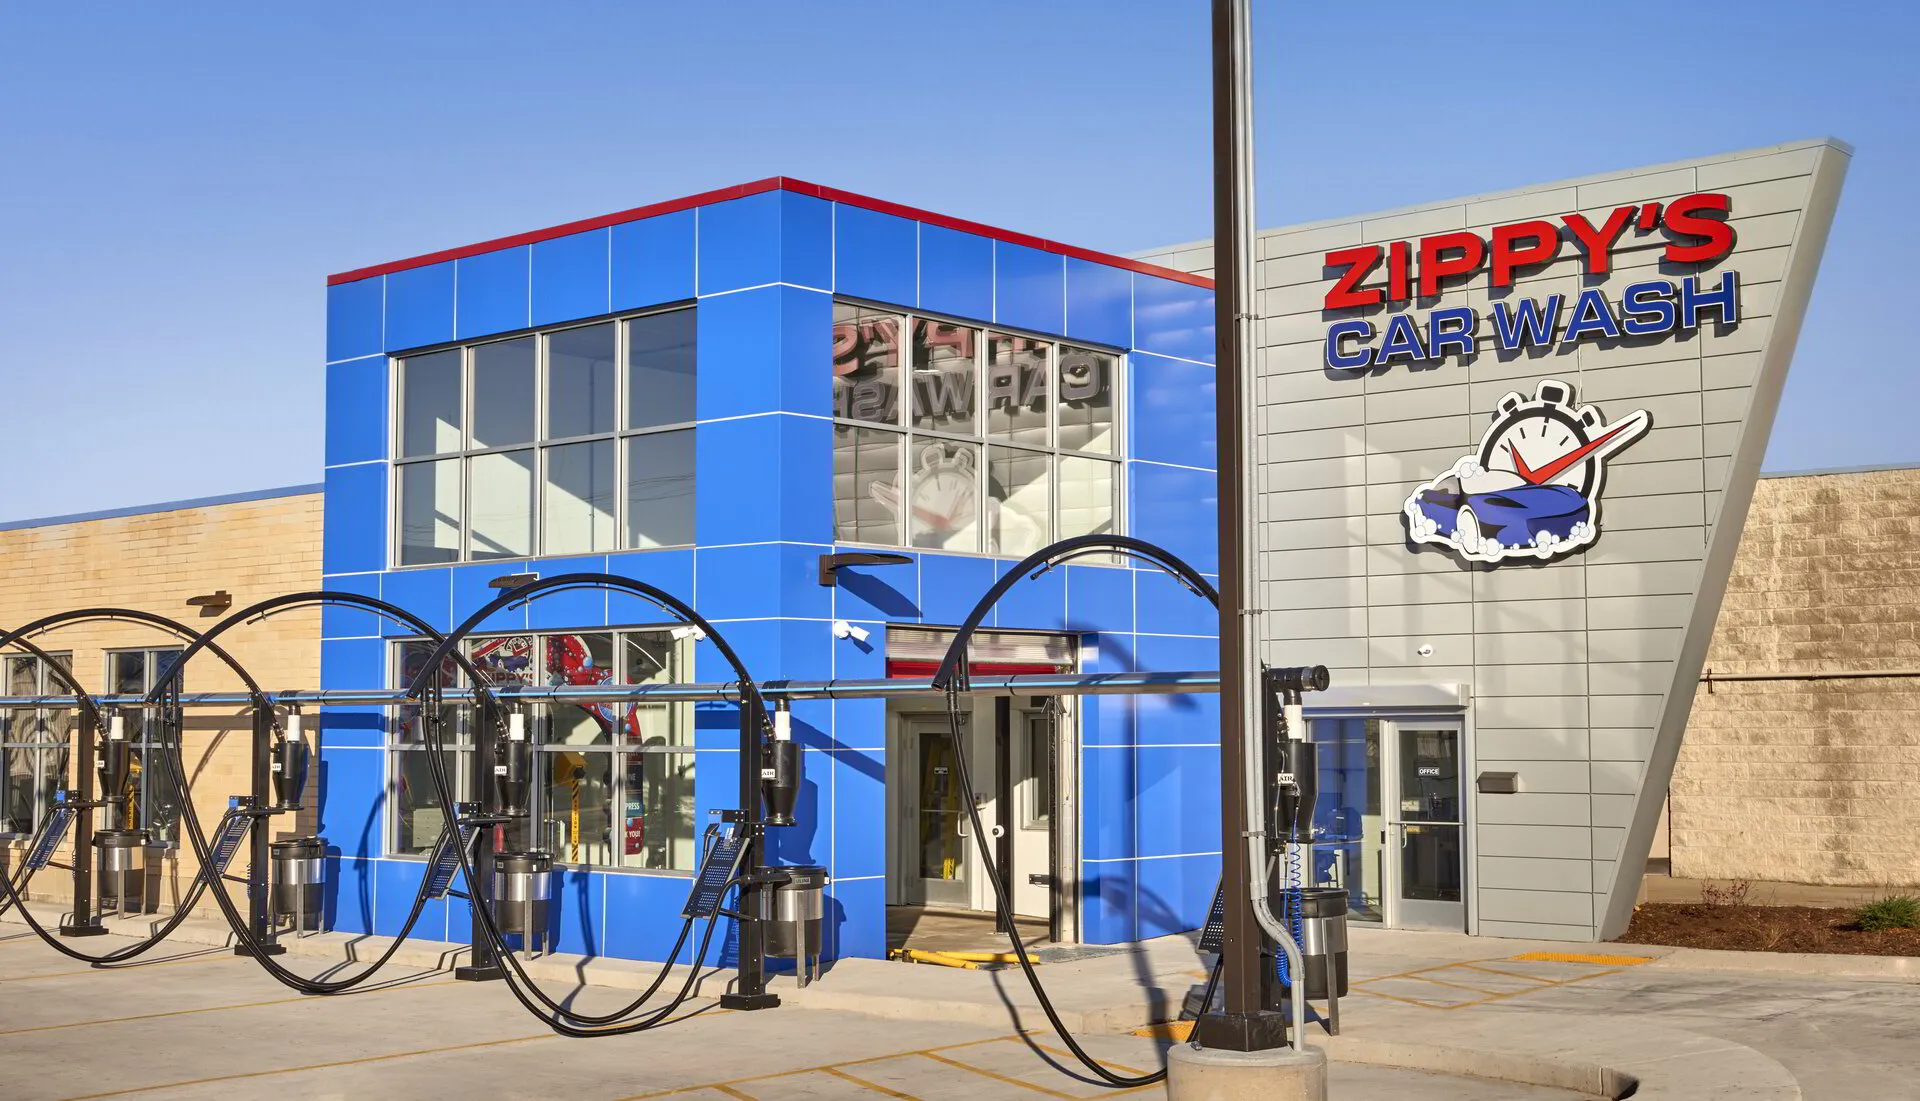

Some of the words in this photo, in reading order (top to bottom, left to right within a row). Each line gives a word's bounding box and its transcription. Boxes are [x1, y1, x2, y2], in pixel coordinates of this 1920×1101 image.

[1324, 193, 1735, 310] ZIPPY'S
[1326, 305, 1475, 370] CAR
[1490, 270, 1737, 350] WASH
